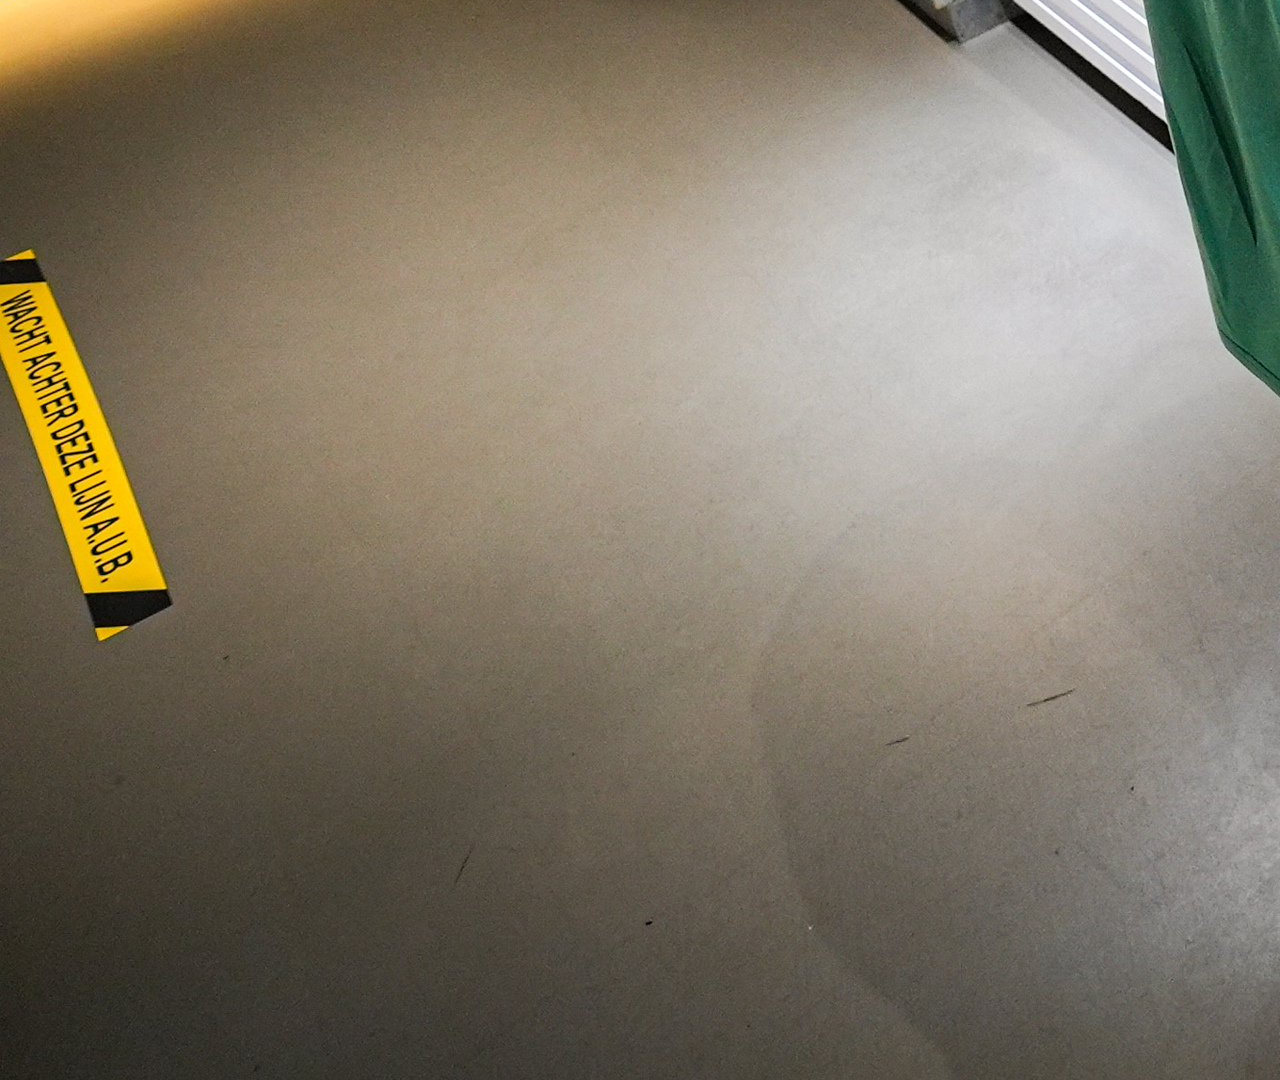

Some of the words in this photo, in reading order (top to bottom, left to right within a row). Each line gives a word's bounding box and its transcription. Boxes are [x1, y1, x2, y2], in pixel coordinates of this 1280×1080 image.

[1, 290, 52, 353] WACHT
[23, 352, 80, 426] ACHTER
[51, 419, 99, 477] DEZE
[68, 469, 120, 521] LIJN
[83, 516, 134, 583] A.U.B.
